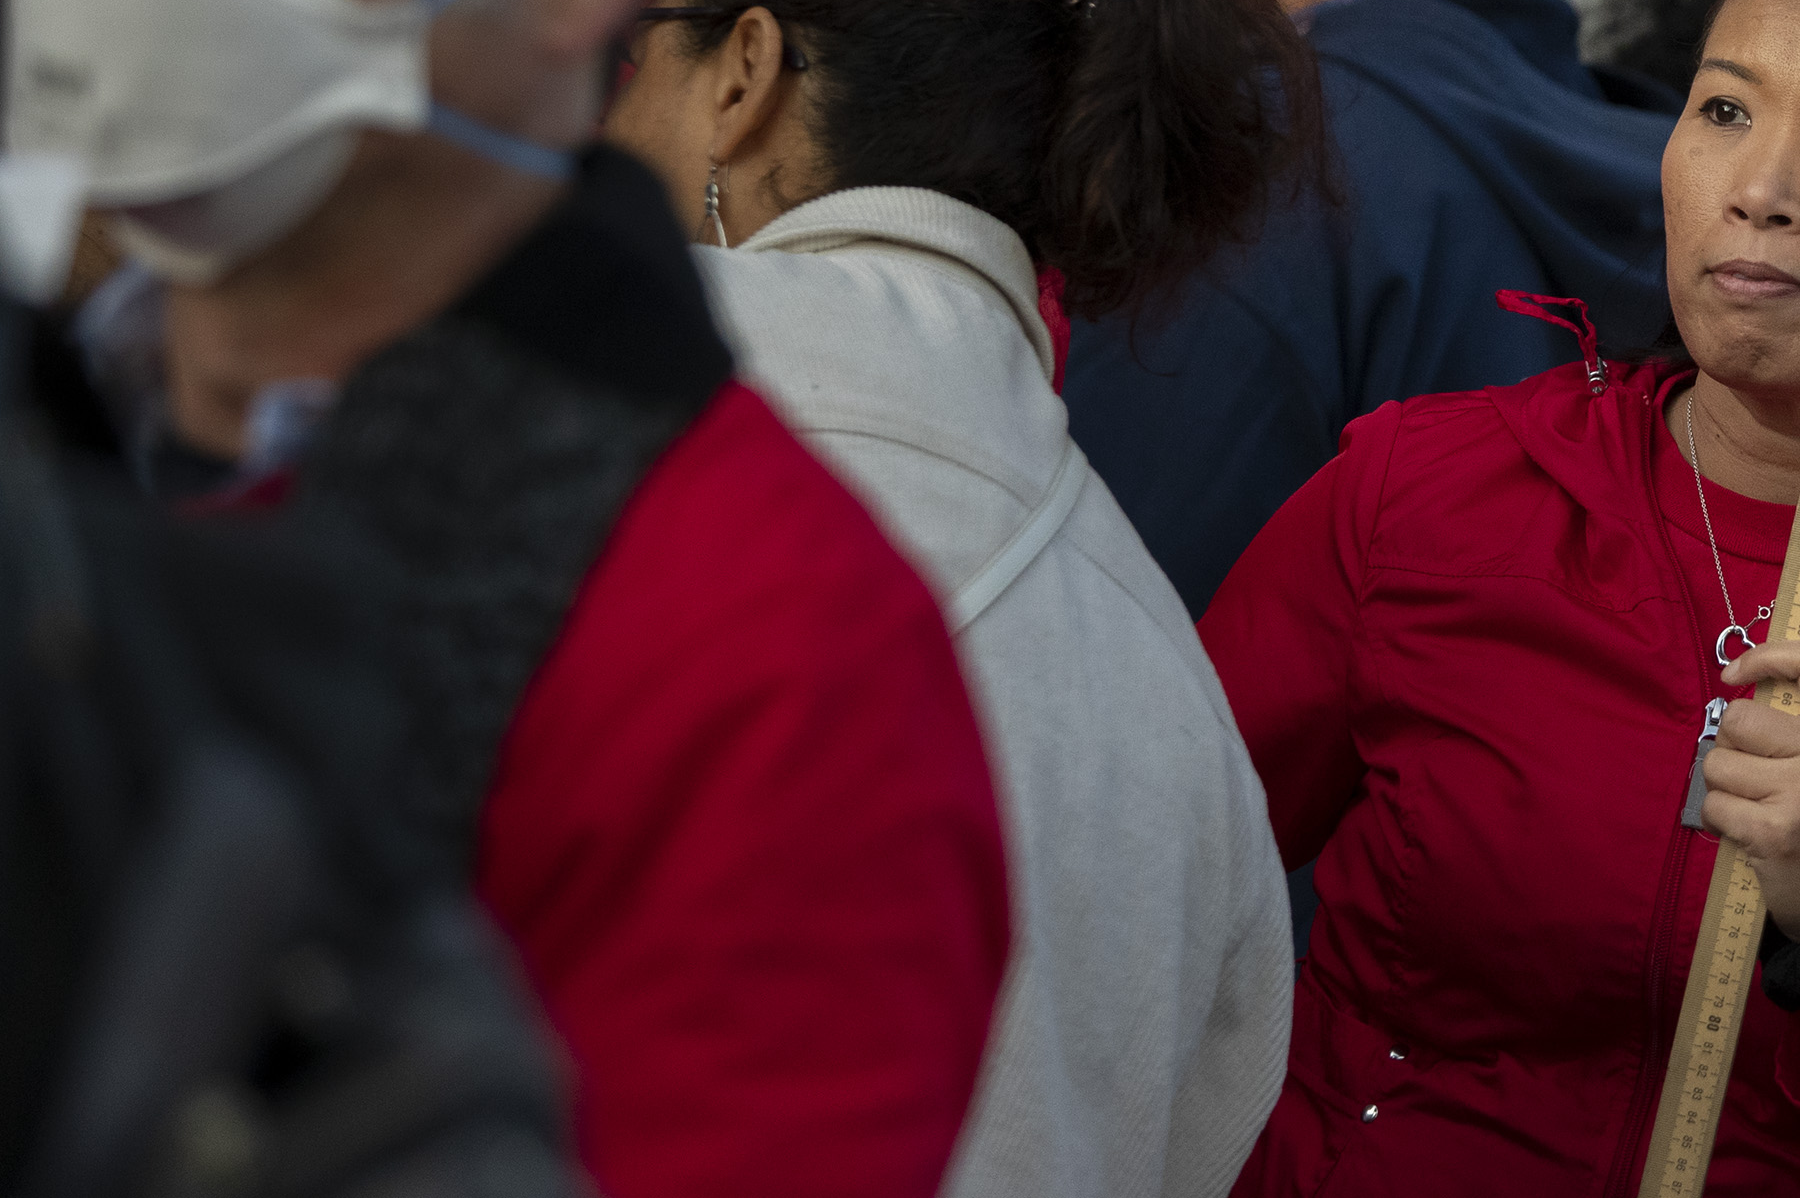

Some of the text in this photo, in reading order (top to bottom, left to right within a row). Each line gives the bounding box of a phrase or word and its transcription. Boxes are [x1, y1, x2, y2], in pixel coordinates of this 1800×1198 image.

[1782, 691, 1794, 706] 66
[1740, 878, 1752, 891] 74
[1734, 902, 1746, 916] 75
[1728, 925, 1741, 939] 76
[1724, 948, 1736, 963] 77
[1718, 971, 1731, 986] 78
[1713, 995, 1725, 1009] 79
[1706, 1014, 1722, 1032] 80
[1701, 1041, 1714, 1056] 81
[1696, 1063, 1709, 1079] 82
[1691, 1087, 1704, 1101] 83
[1686, 1110, 1698, 1125] 84
[1681, 1135, 1694, 1150] 85
[1675, 1157, 1688, 1172] 86
[1671, 1179, 1683, 1195] 87
